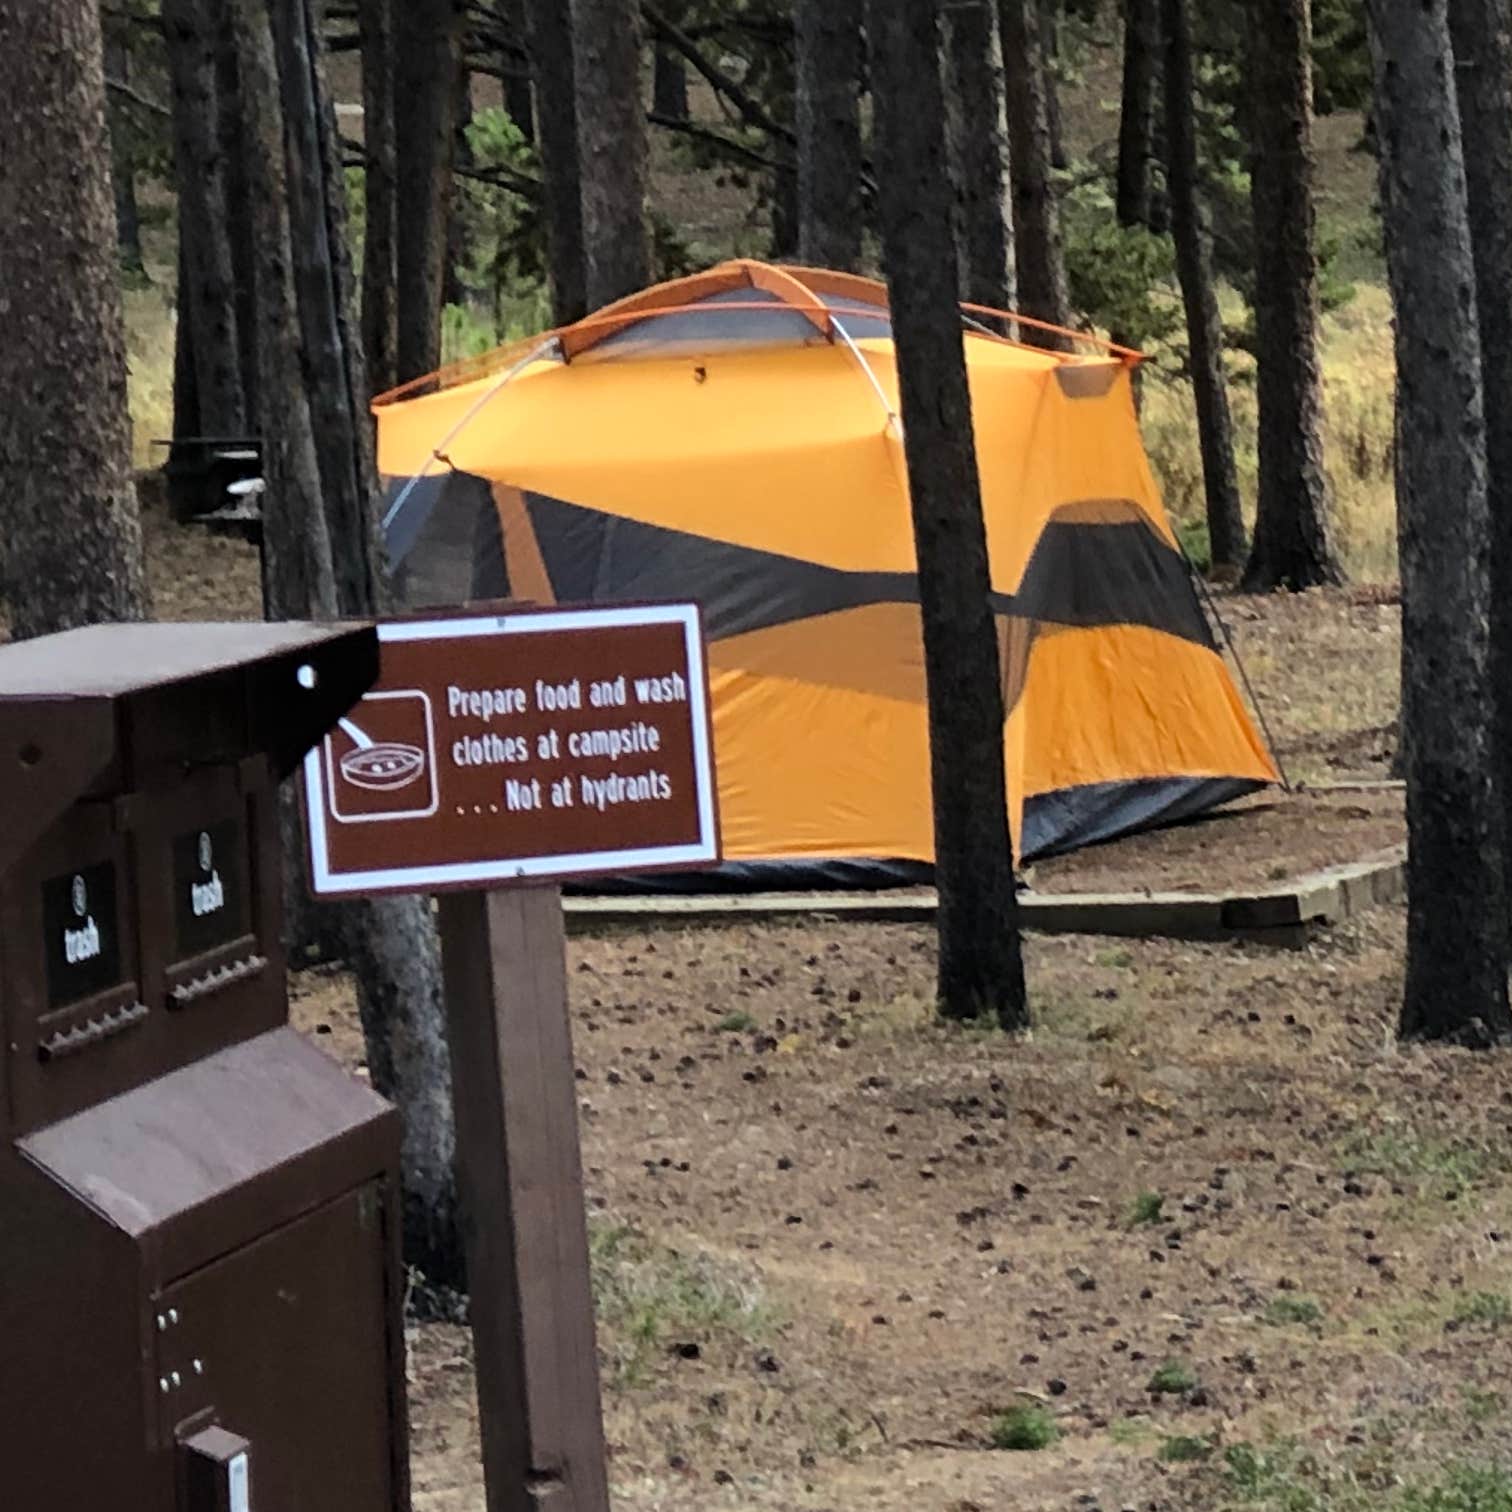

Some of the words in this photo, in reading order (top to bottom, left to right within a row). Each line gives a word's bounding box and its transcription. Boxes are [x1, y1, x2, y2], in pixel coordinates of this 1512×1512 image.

[447, 683, 527, 721] Prepare
[536, 678, 581, 711] food
[589, 674, 626, 707] and
[634, 671, 686, 704] wash
[452, 732, 529, 767] clothes
[537, 732, 560, 761] at
[568, 721, 661, 762] campsite
[550, 775, 574, 807] at
[581, 769, 671, 811] hydrants
